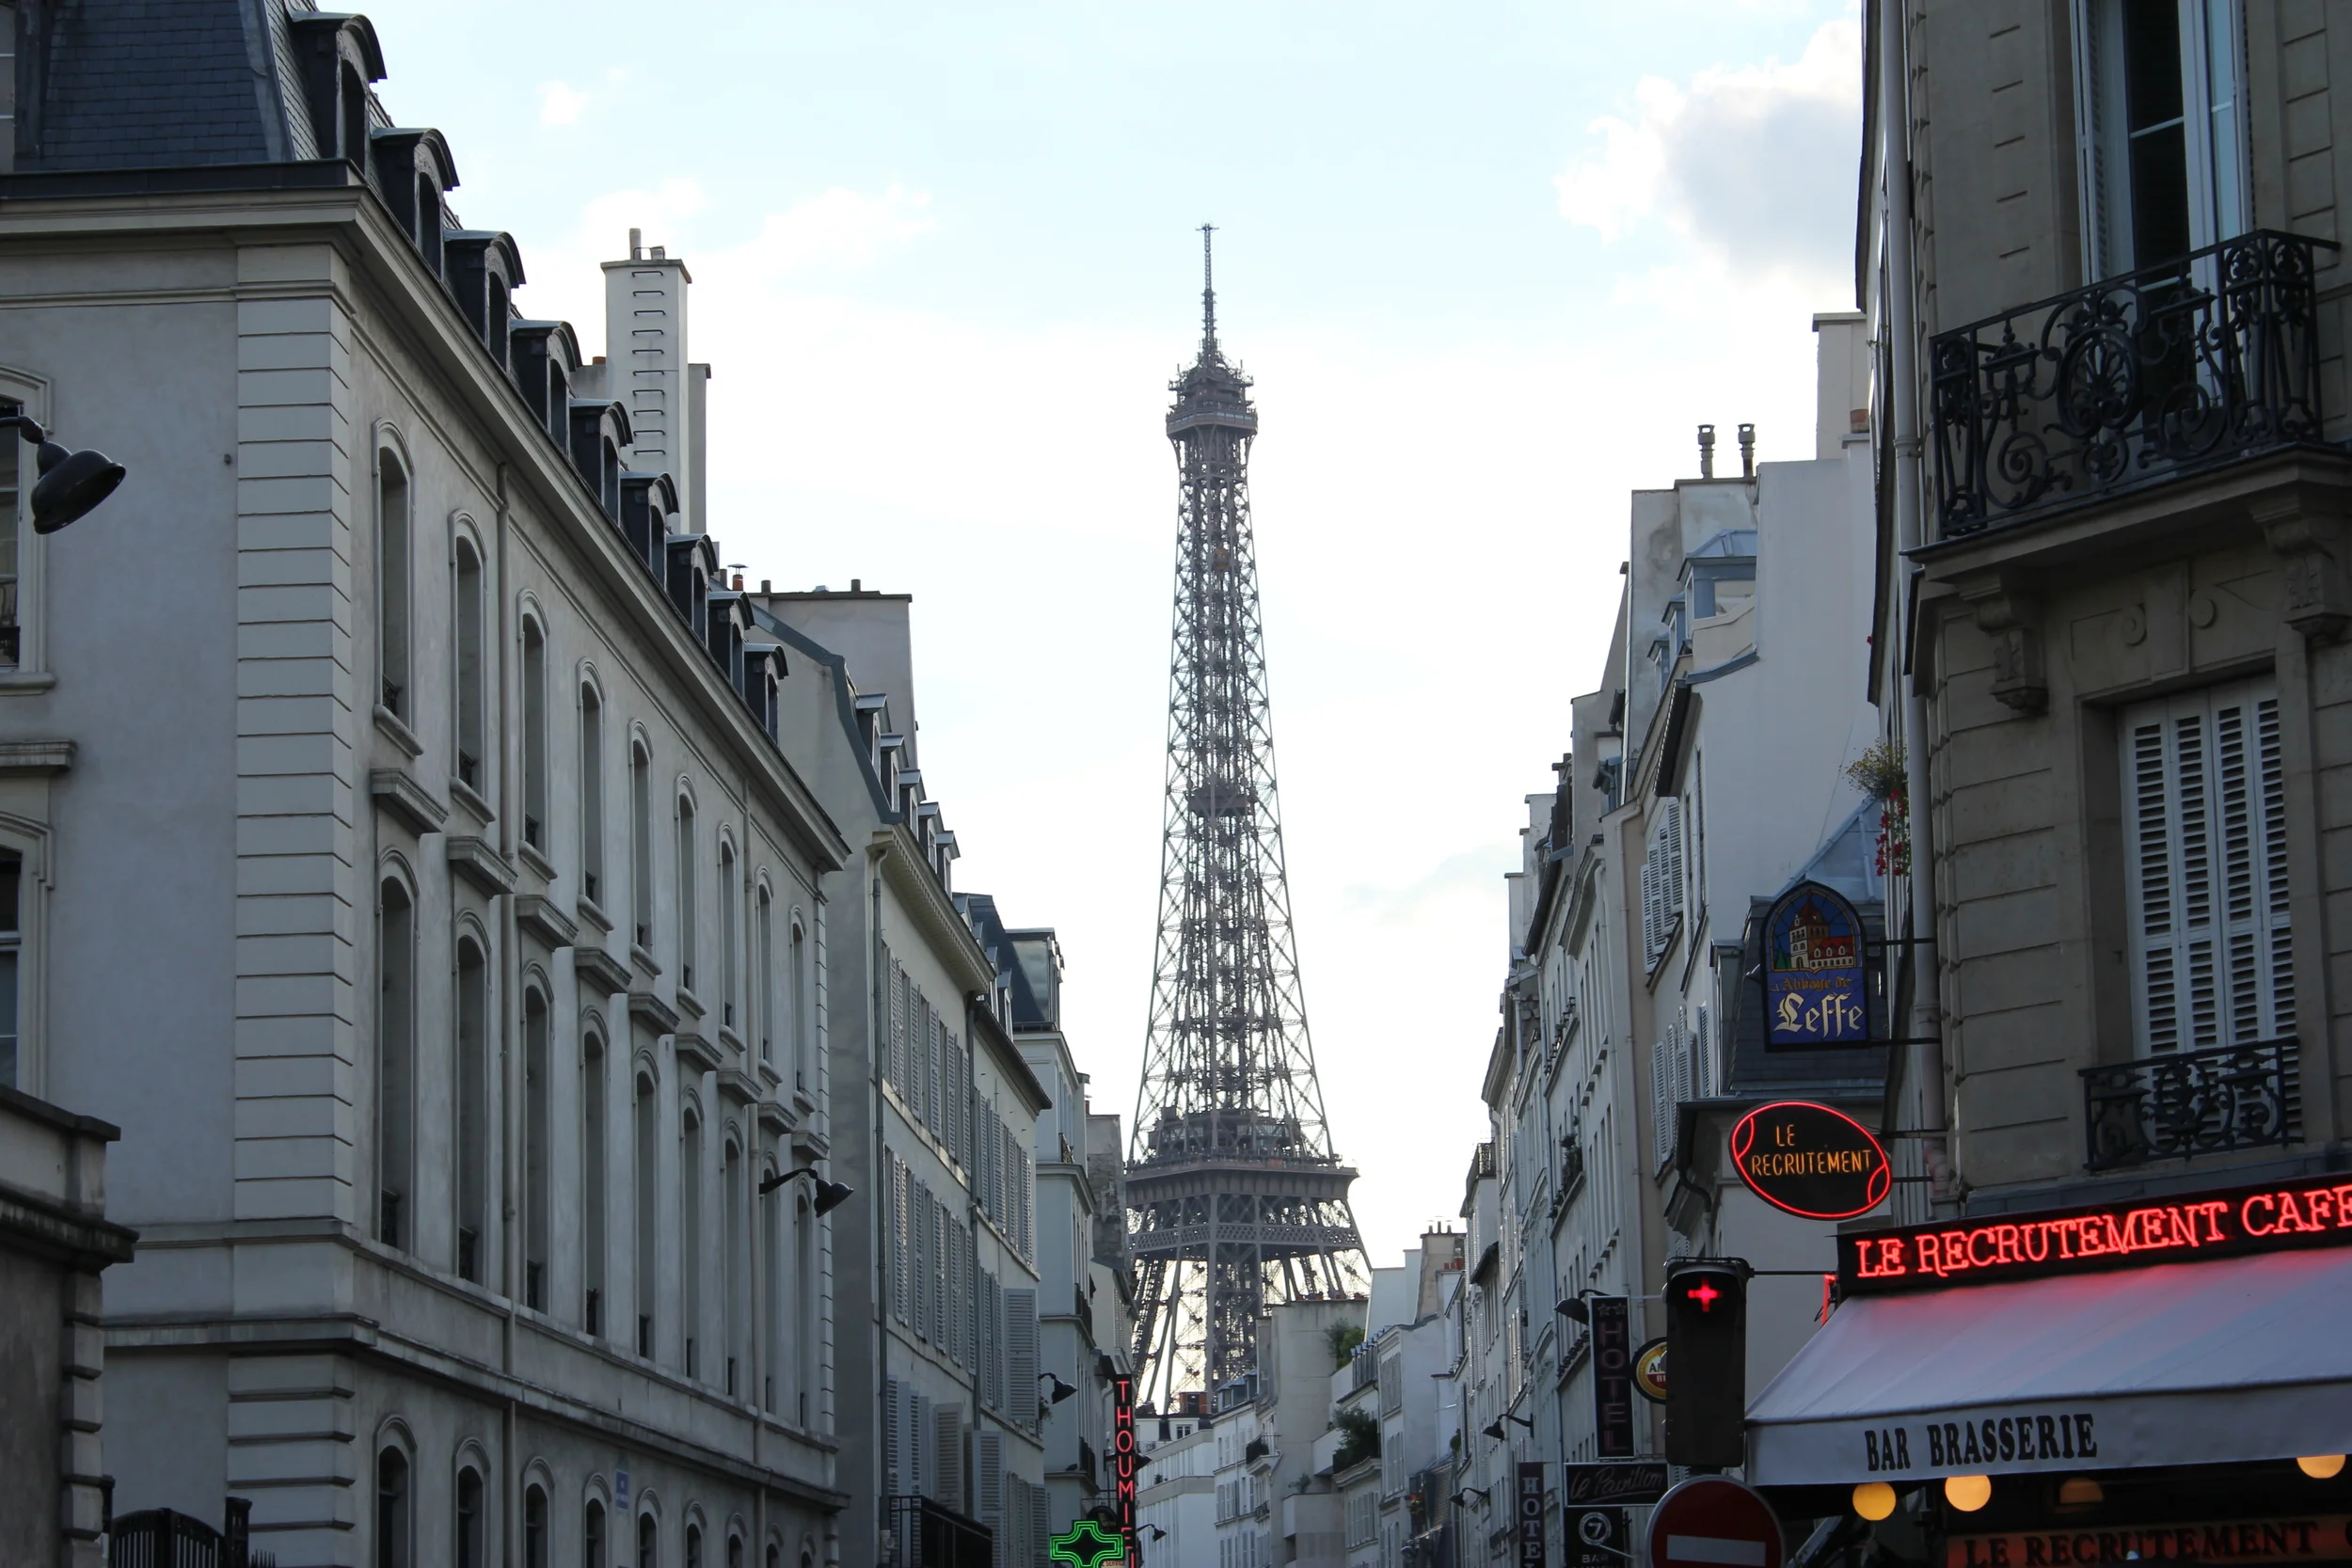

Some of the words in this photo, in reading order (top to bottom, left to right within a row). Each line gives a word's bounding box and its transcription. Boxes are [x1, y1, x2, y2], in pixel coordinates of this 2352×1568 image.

[1773, 991, 1864, 1038] Leffe
[1775, 1124, 1796, 1147] LE
[1751, 1149, 1872, 1177] RECRUTEMENT
[1854, 1238, 1905, 1277] LE
[1915, 1200, 2229, 1277] RECRUTEMENT
[1599, 1322, 1629, 1451] HOTEL
[1865, 1427, 1911, 1471] BAR
[1927, 1414, 2097, 1466] BRASSERIE
[1594, 1465, 1665, 1496] Pavillon
[1581, 1554, 1609, 1563] BAR
[1964, 1538, 2010, 1568] LE
[2025, 1520, 2318, 1568] RECRUTEMENT
